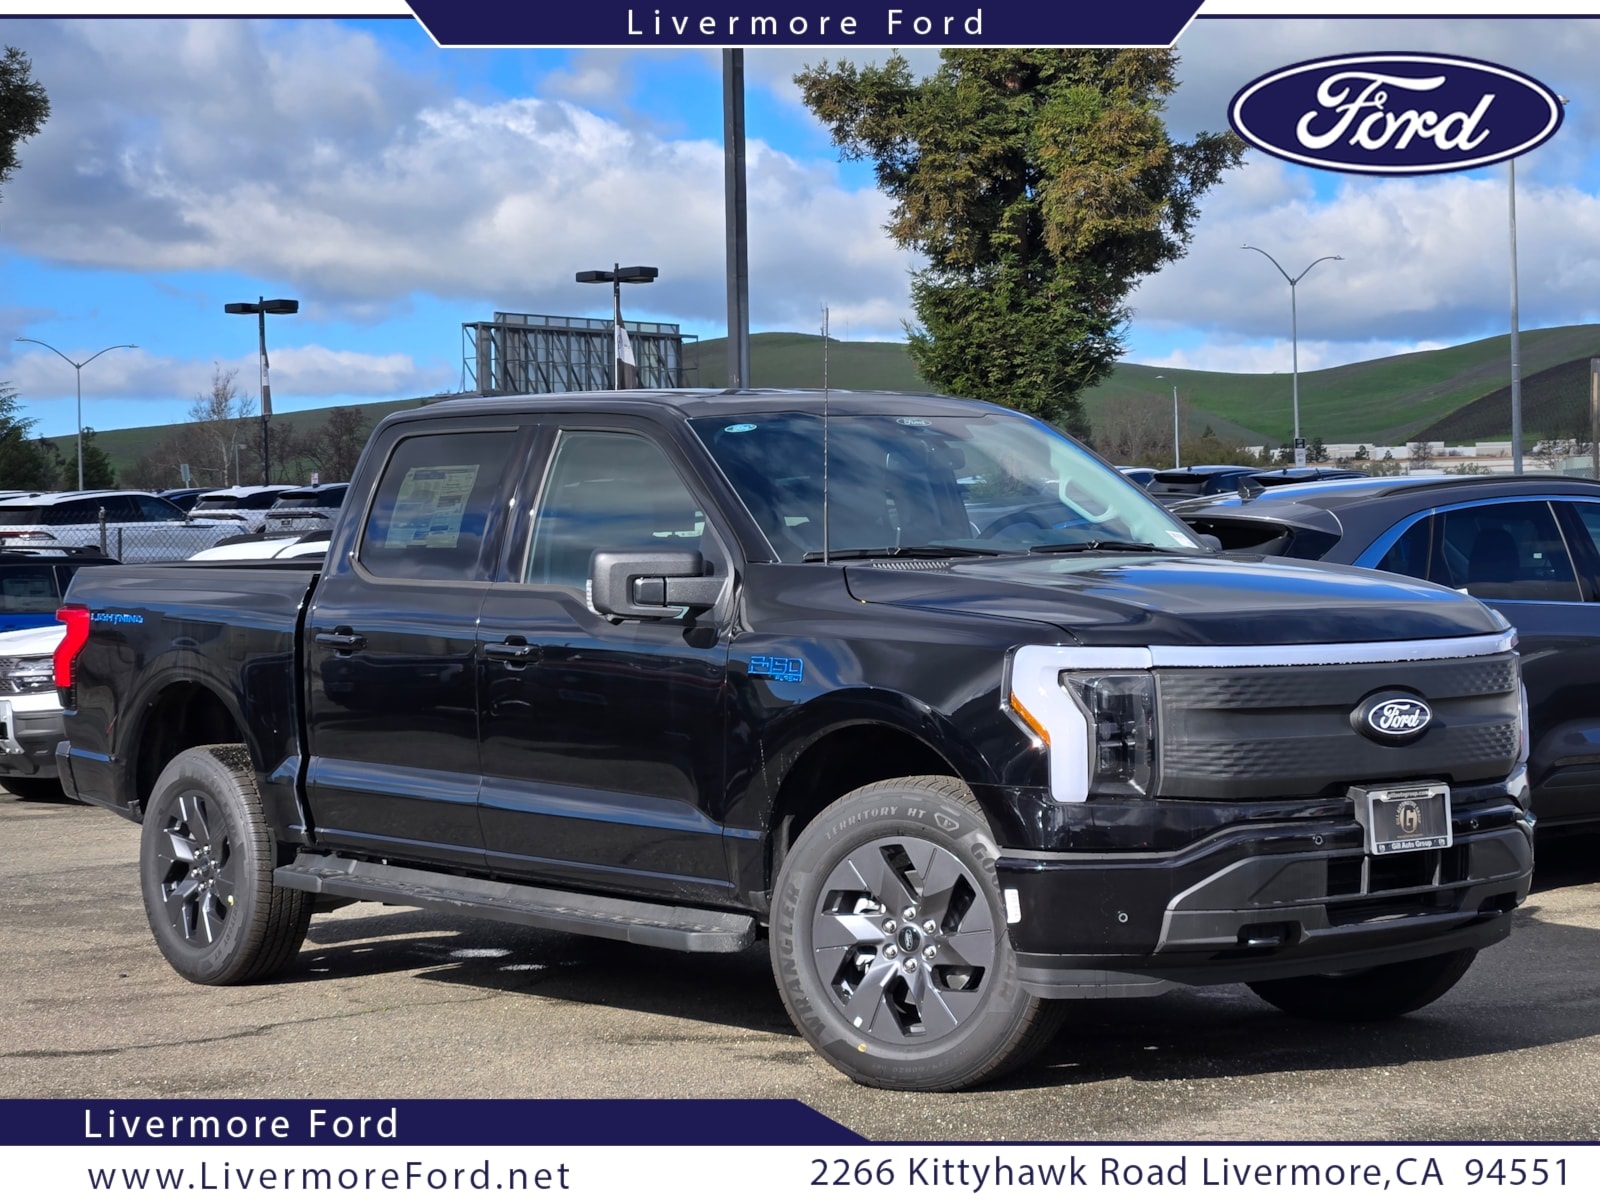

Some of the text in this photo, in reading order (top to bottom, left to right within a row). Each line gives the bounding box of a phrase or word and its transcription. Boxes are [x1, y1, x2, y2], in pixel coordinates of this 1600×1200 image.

[91, 612, 144, 624] LIGHTNING
[1380, 704, 1420, 728] Ford
[825, 806, 928, 841] TERRITORY HT
[1391, 842, 1401, 850] Gill
[1402, 841, 1415, 849] Auto
[1415, 840, 1433, 848] Group
[779, 882, 828, 1038] WRANGLER
